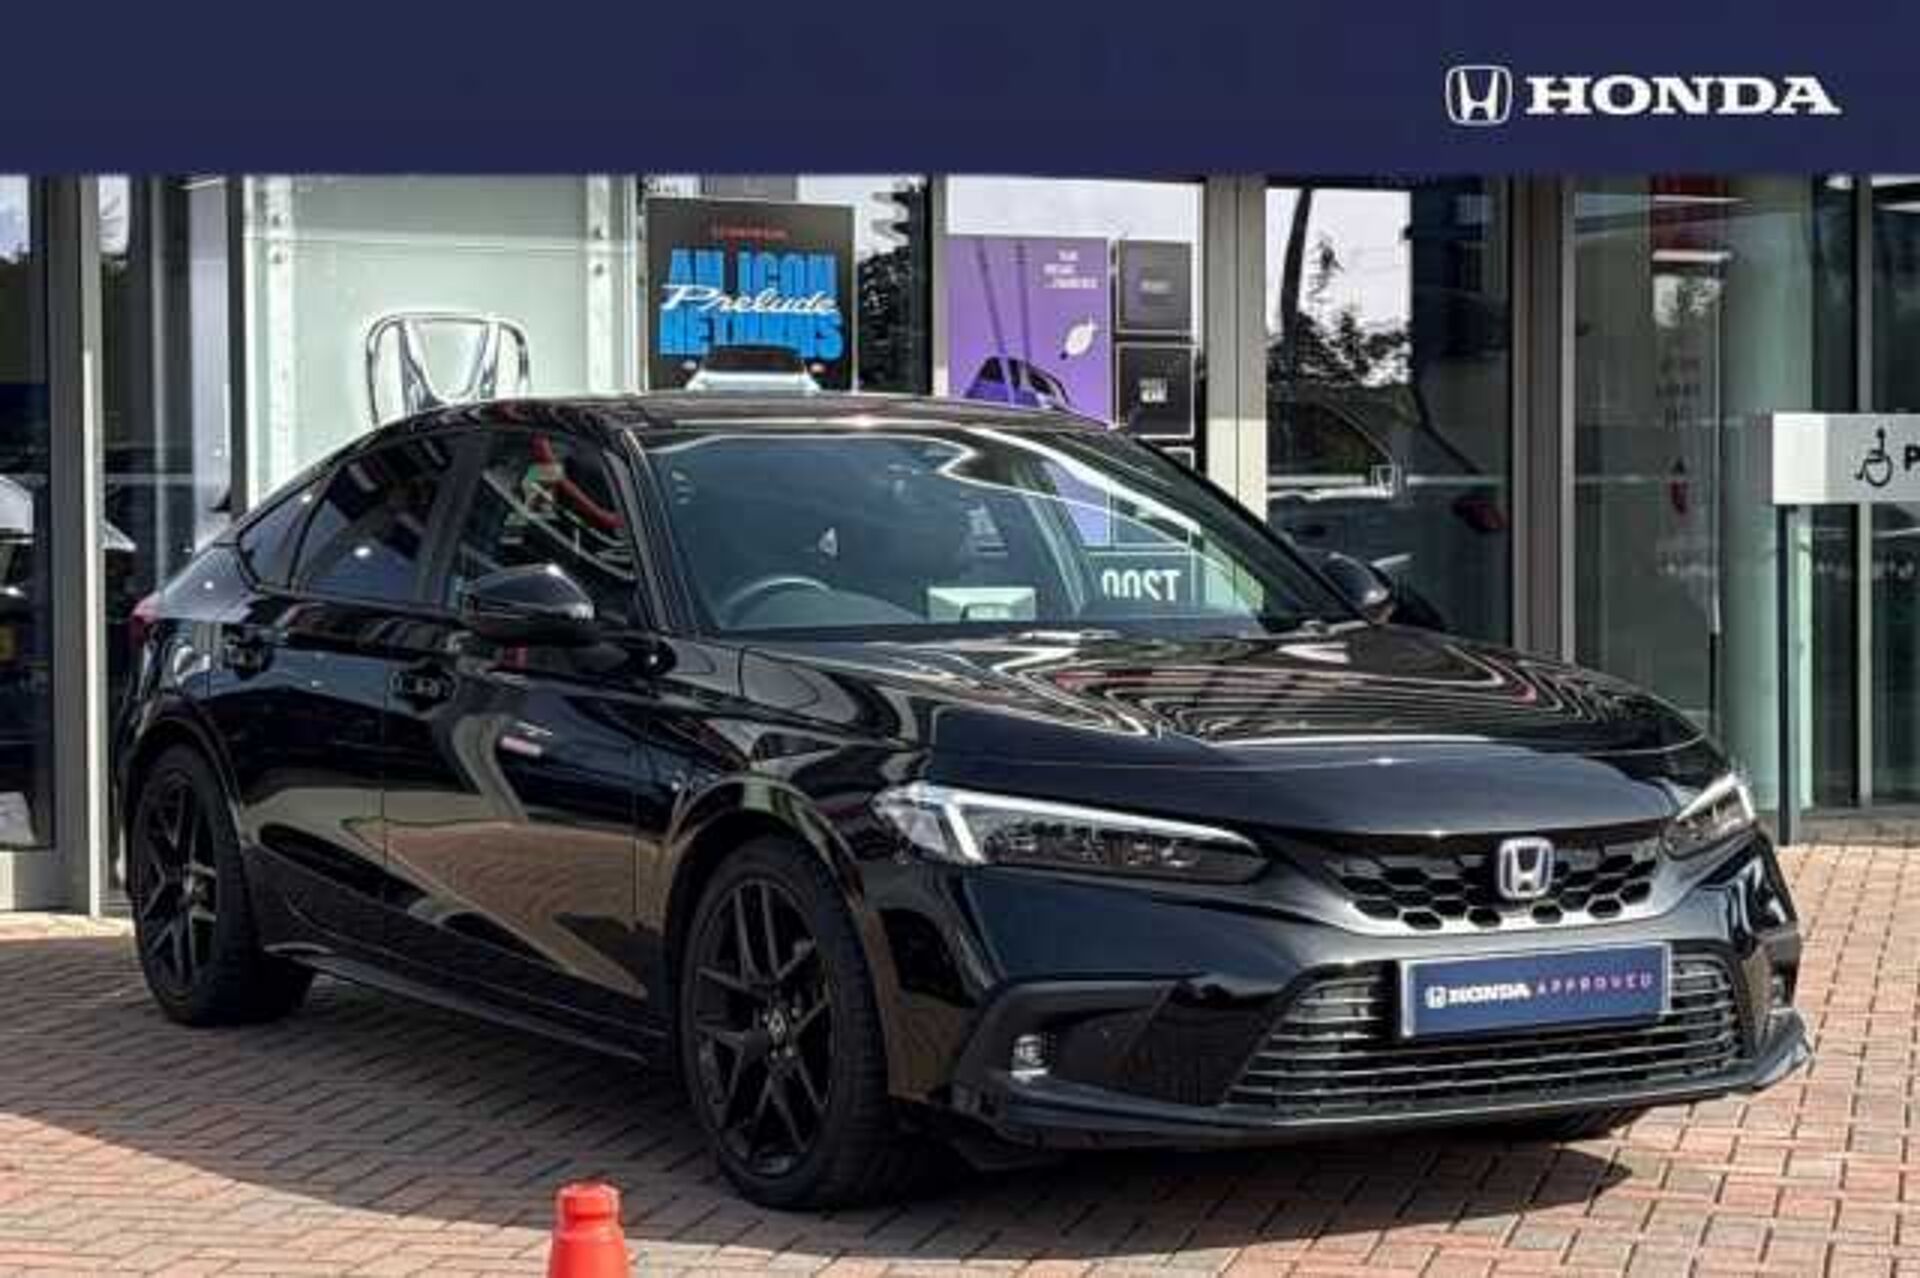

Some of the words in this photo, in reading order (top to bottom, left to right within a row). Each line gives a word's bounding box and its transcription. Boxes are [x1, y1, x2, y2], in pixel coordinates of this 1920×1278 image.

[660, 284, 840, 315] Prelude
[1448, 982, 1533, 1004] HONDA
[1537, 972, 1653, 996] APPROVED
